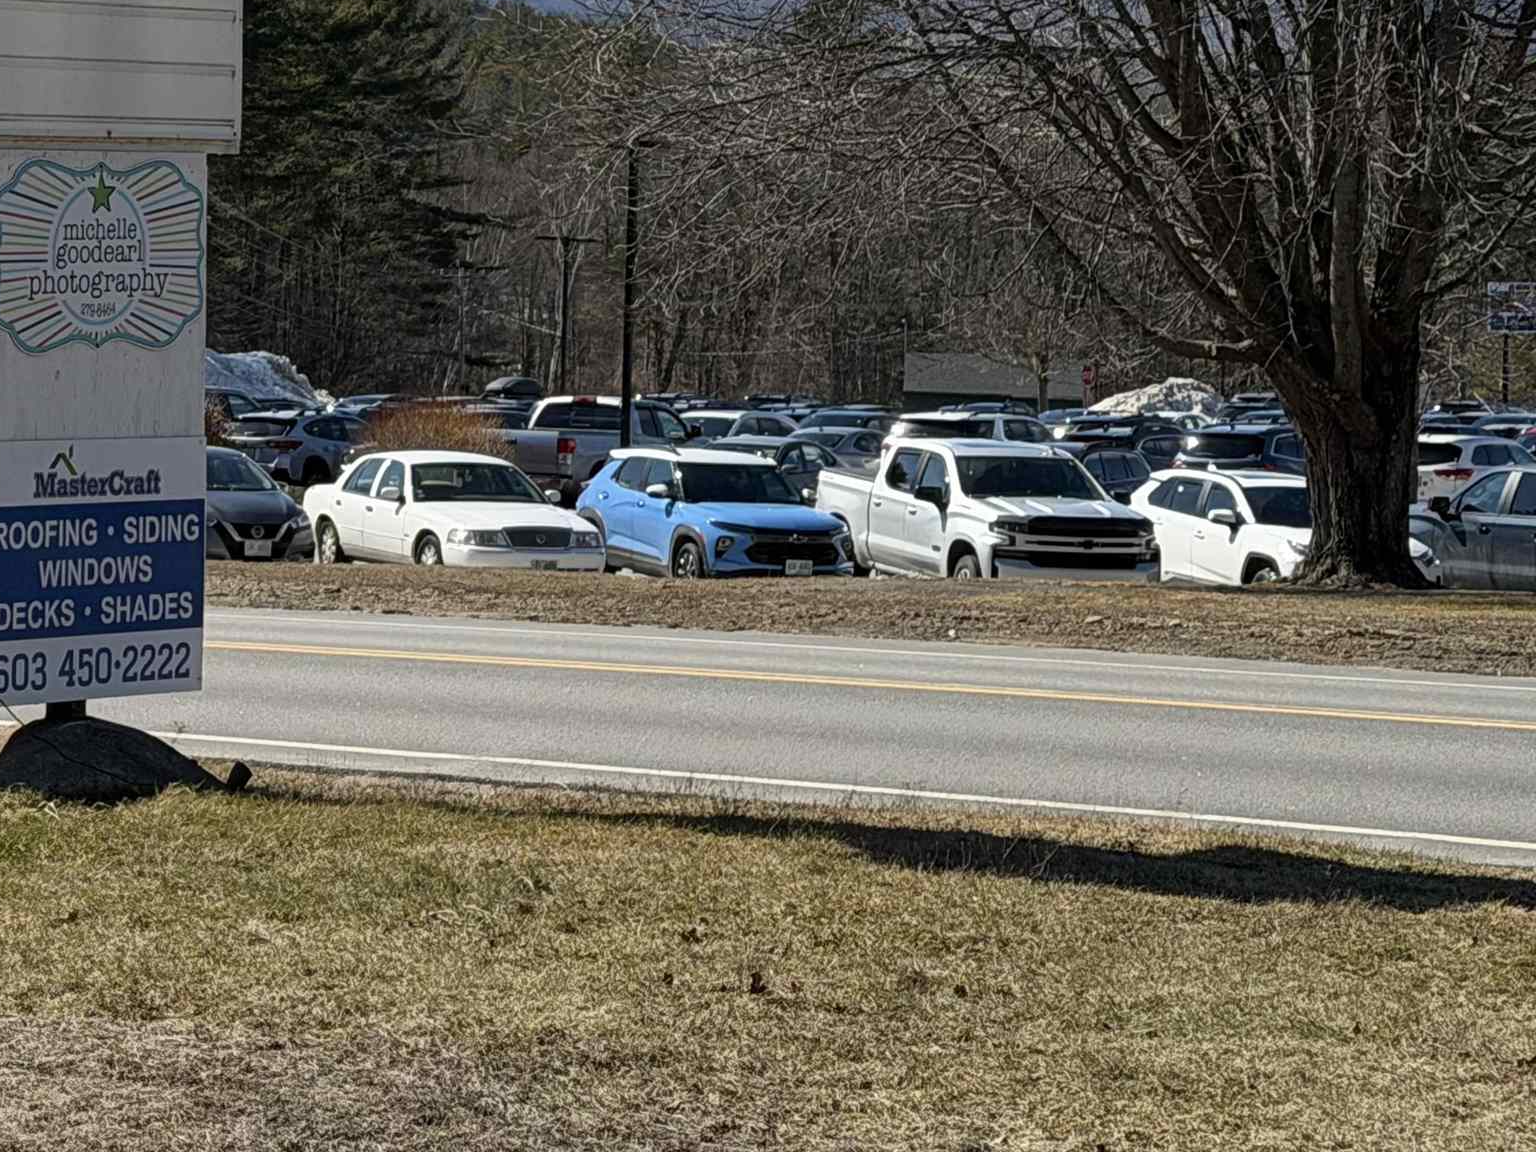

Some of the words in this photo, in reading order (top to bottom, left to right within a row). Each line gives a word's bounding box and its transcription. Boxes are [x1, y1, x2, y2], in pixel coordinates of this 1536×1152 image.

[64, 218, 137, 240] michelle
[56, 240, 144, 269] goodearl
[27, 268, 169, 300] photography
[33, 468, 161, 498] MasterCraft
[123, 513, 199, 544] SIDING
[39, 555, 153, 588] WINDOWS
[100, 591, 192, 625] SHADES
